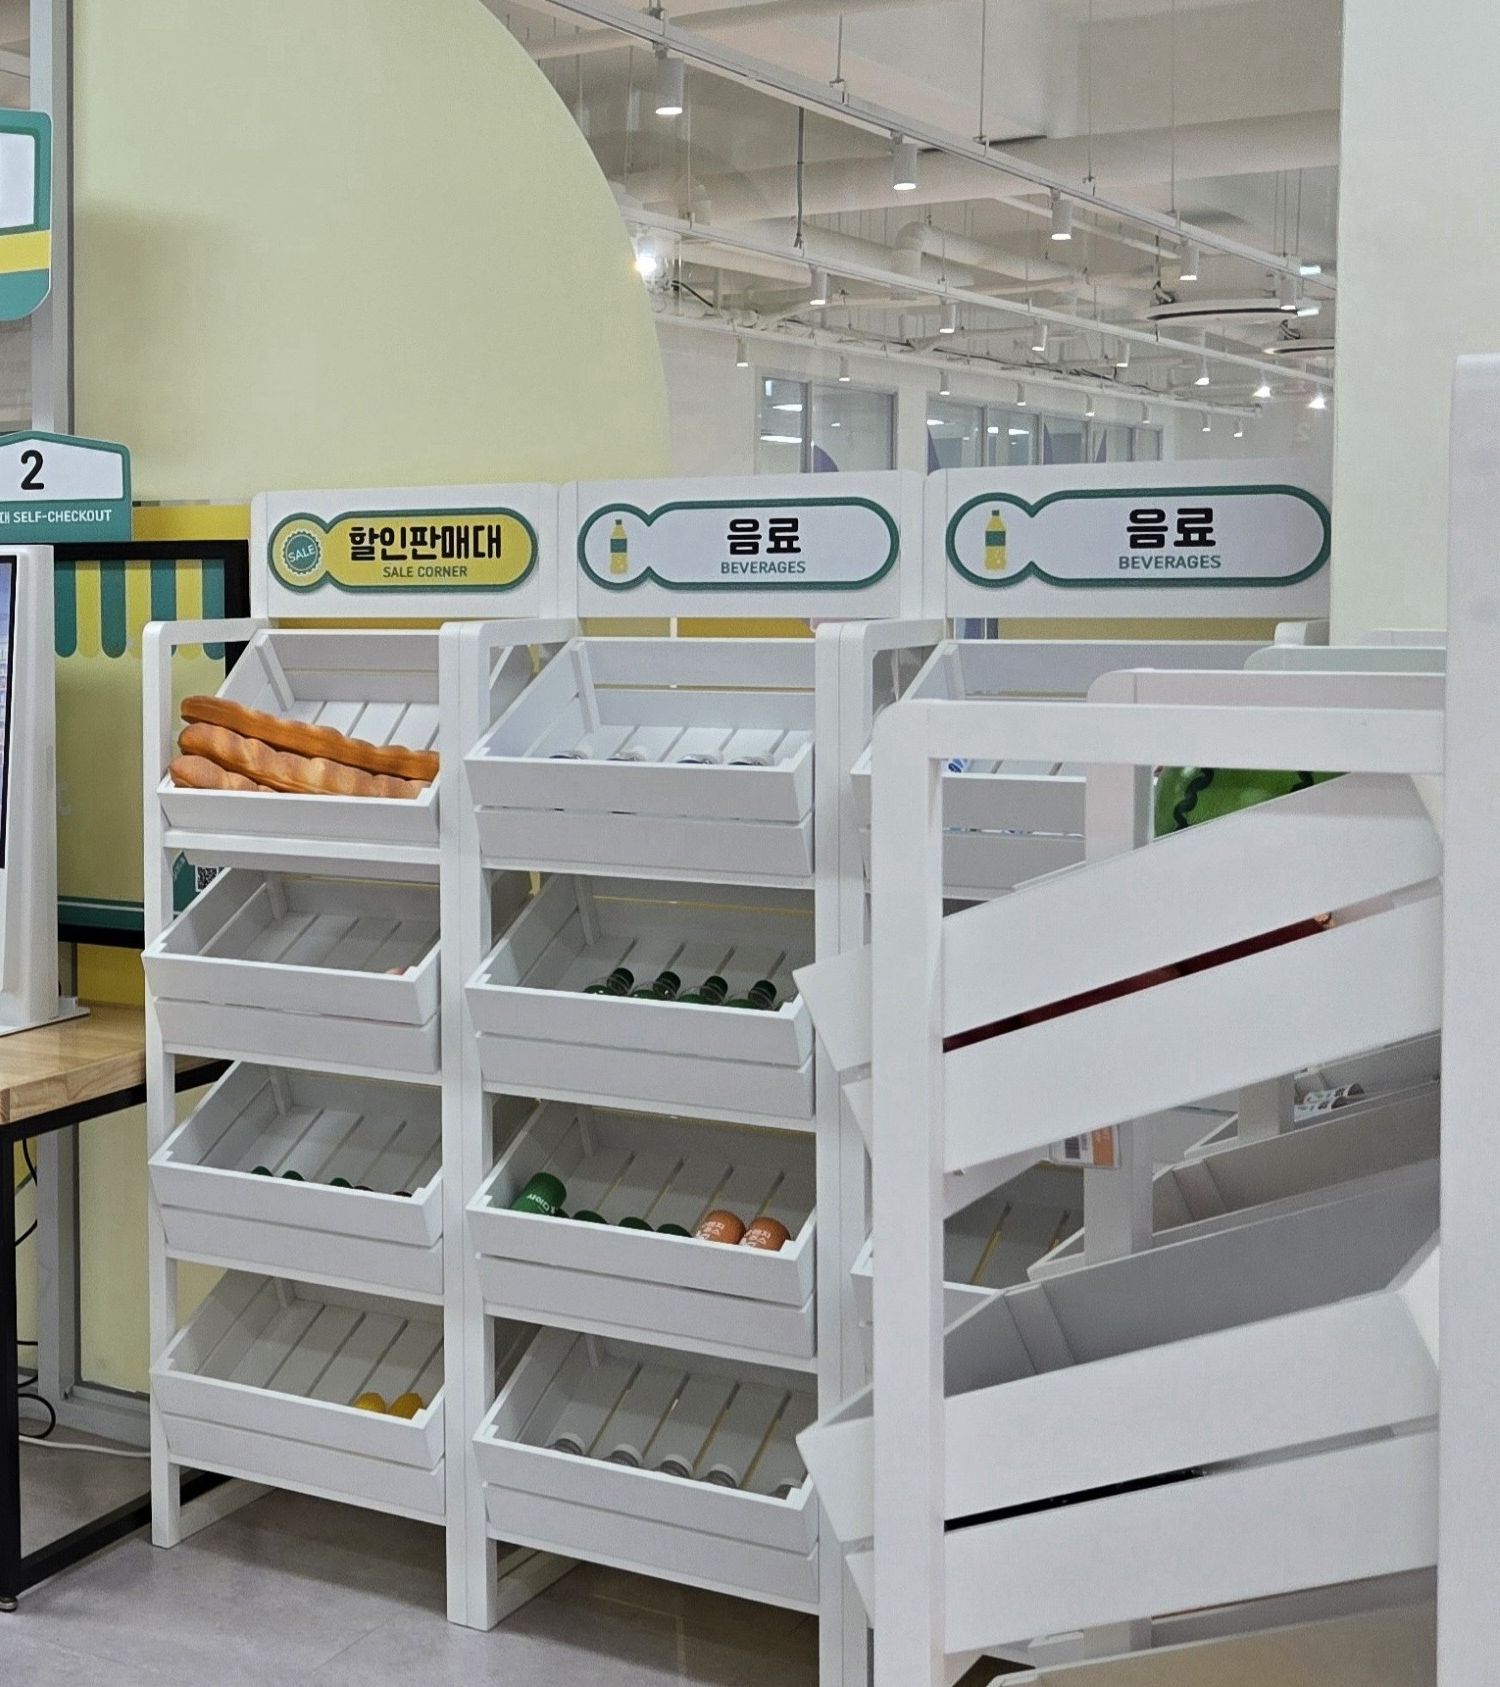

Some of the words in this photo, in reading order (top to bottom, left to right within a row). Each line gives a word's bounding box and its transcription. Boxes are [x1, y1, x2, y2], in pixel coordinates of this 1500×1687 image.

[20, 449, 45, 490] 2
[13, 509, 112, 524] SELF-CHECKOUT
[727, 517, 801, 555] 음료
[1126, 507, 1217, 549] 음료
[349, 524, 501, 561] 할인판매대
[288, 544, 316, 563] SALE
[1118, 555, 1221, 570] BEVERAGES
[383, 566, 414, 578] SALE
[417, 565, 468, 578] CORNER
[720, 561, 806, 574] BEVERAGES
